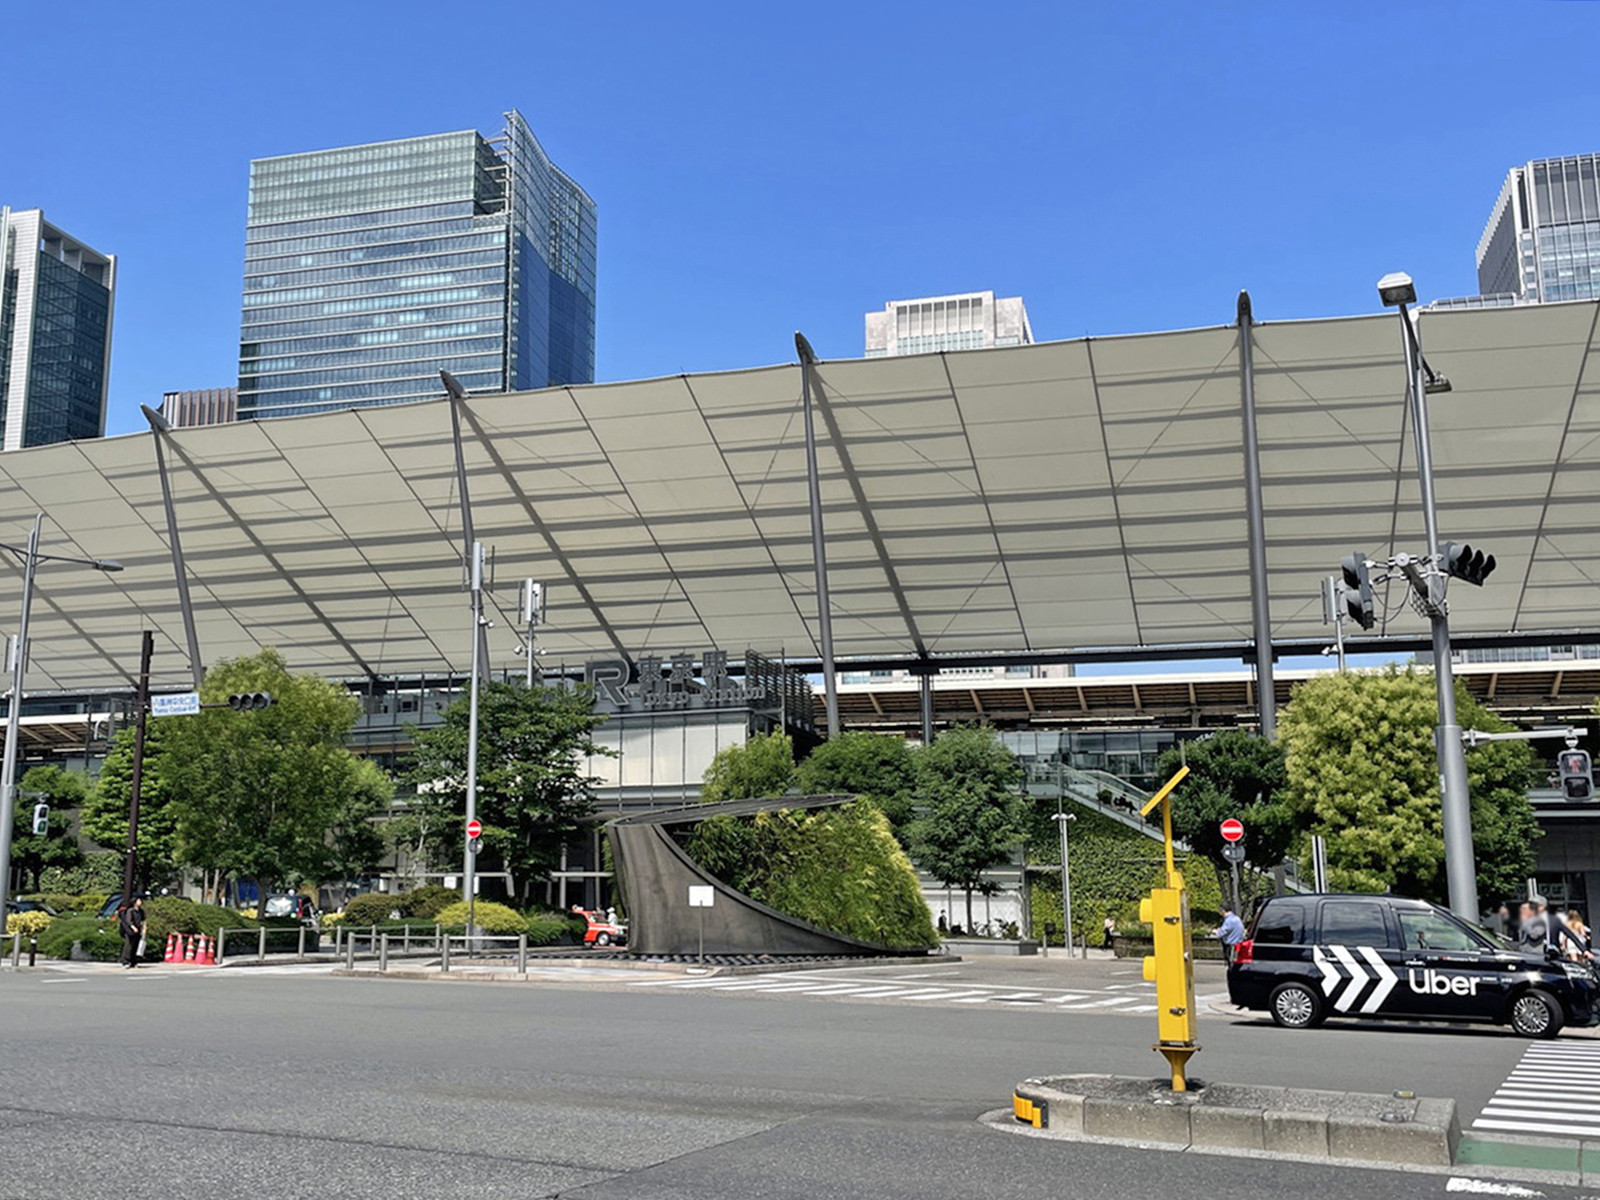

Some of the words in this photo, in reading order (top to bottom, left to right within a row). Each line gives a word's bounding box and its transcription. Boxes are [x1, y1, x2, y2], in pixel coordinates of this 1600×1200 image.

[637, 650, 728, 682] 東京駅
[1408, 968, 1480, 996] Uber
